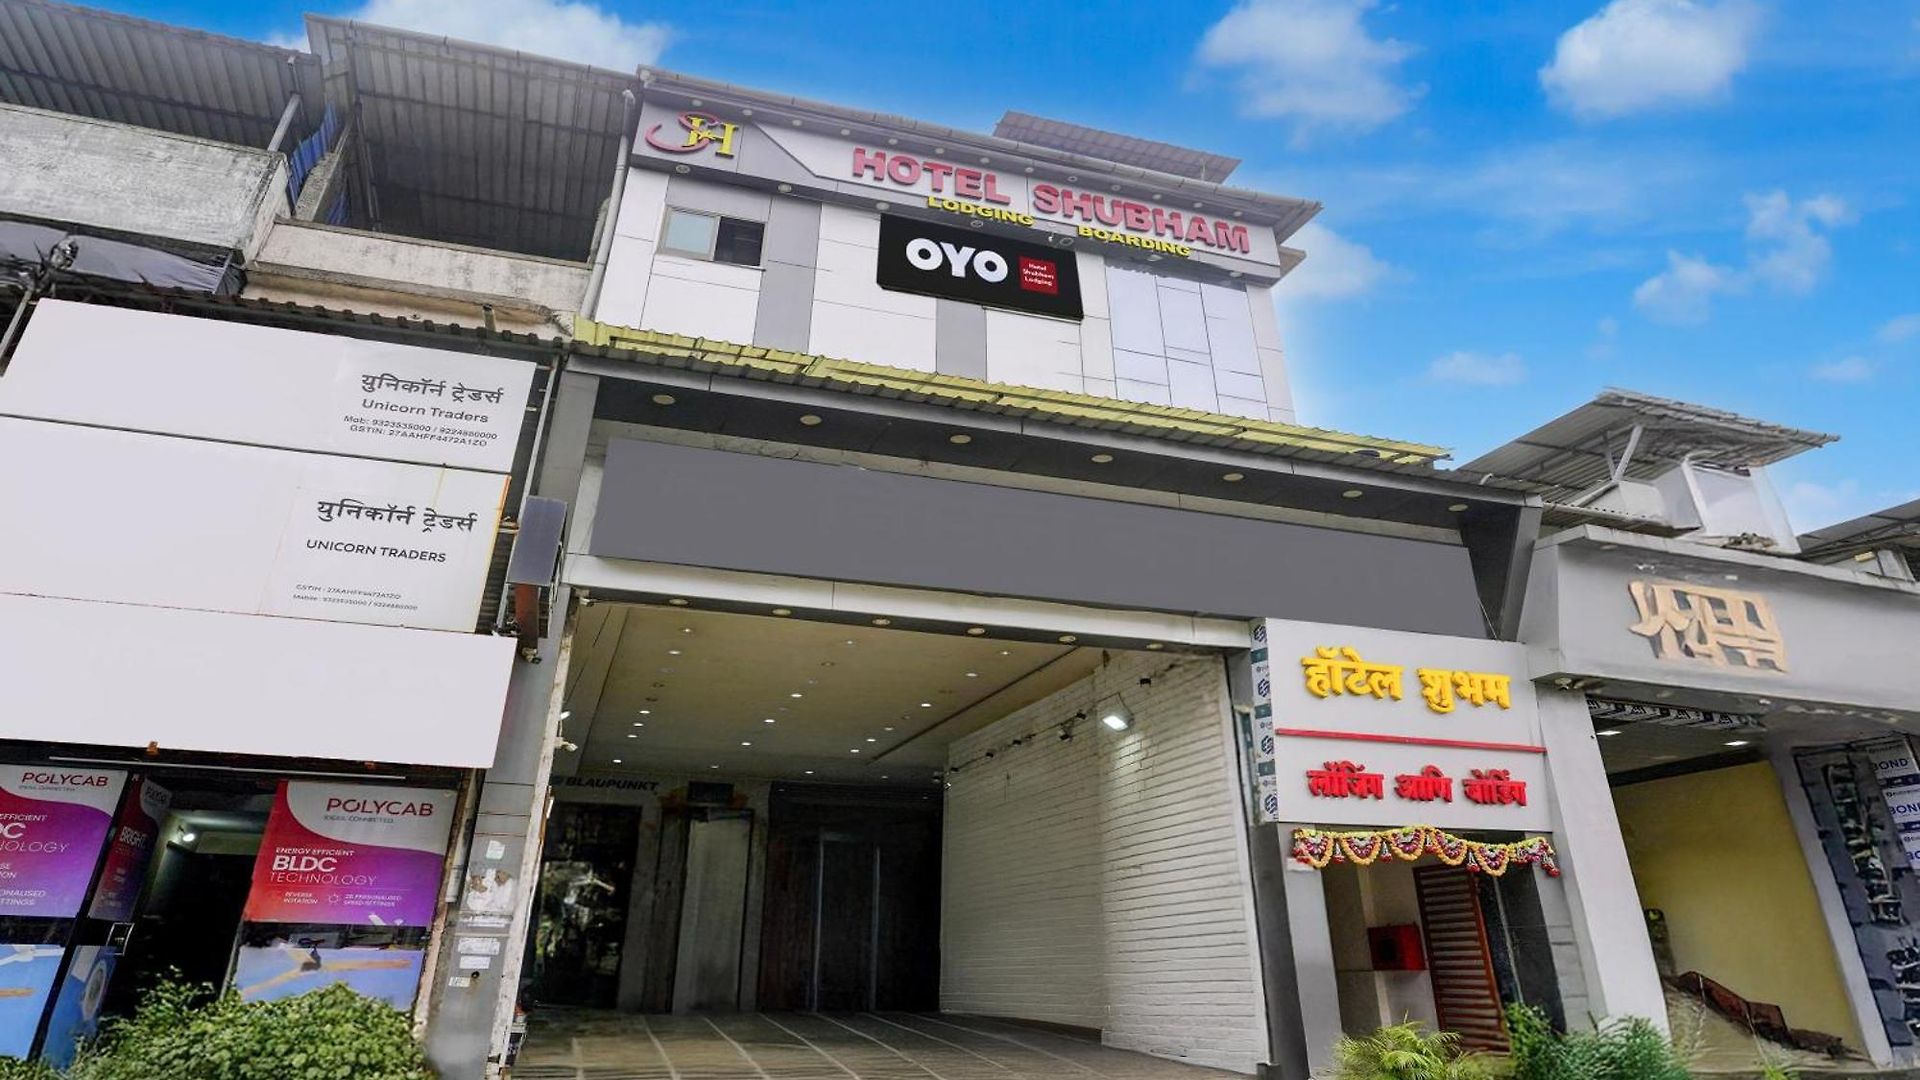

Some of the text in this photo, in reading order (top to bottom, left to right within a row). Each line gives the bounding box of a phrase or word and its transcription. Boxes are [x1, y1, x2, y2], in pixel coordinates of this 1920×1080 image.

[852, 147, 1250, 253] HOTEL SHUBHAM
[927, 196, 1193, 258] LODGING BOARDING
[905, 237, 1009, 283] OYO
[361, 373, 504, 403] युनिकॉर्न ट्रेडर्स
[362, 399, 489, 423] Unicorn Traders
[317, 498, 478, 533] युनिकॉर्न ट्रेडर्स
[306, 539, 447, 563] UNICORN TRADERS
[1301, 646, 1512, 713] हॉटेल शुभम
[22, 772, 109, 787] POLYCAB
[566, 776, 660, 791] BLAUPUNKT
[1394, 764, 1453, 803] आणि
[326, 797, 433, 817] POLYCAB
[276, 847, 311, 856] ENERGY
[272, 855, 338, 873] BLDC
[270, 871, 377, 887] TECHNOLOGY
